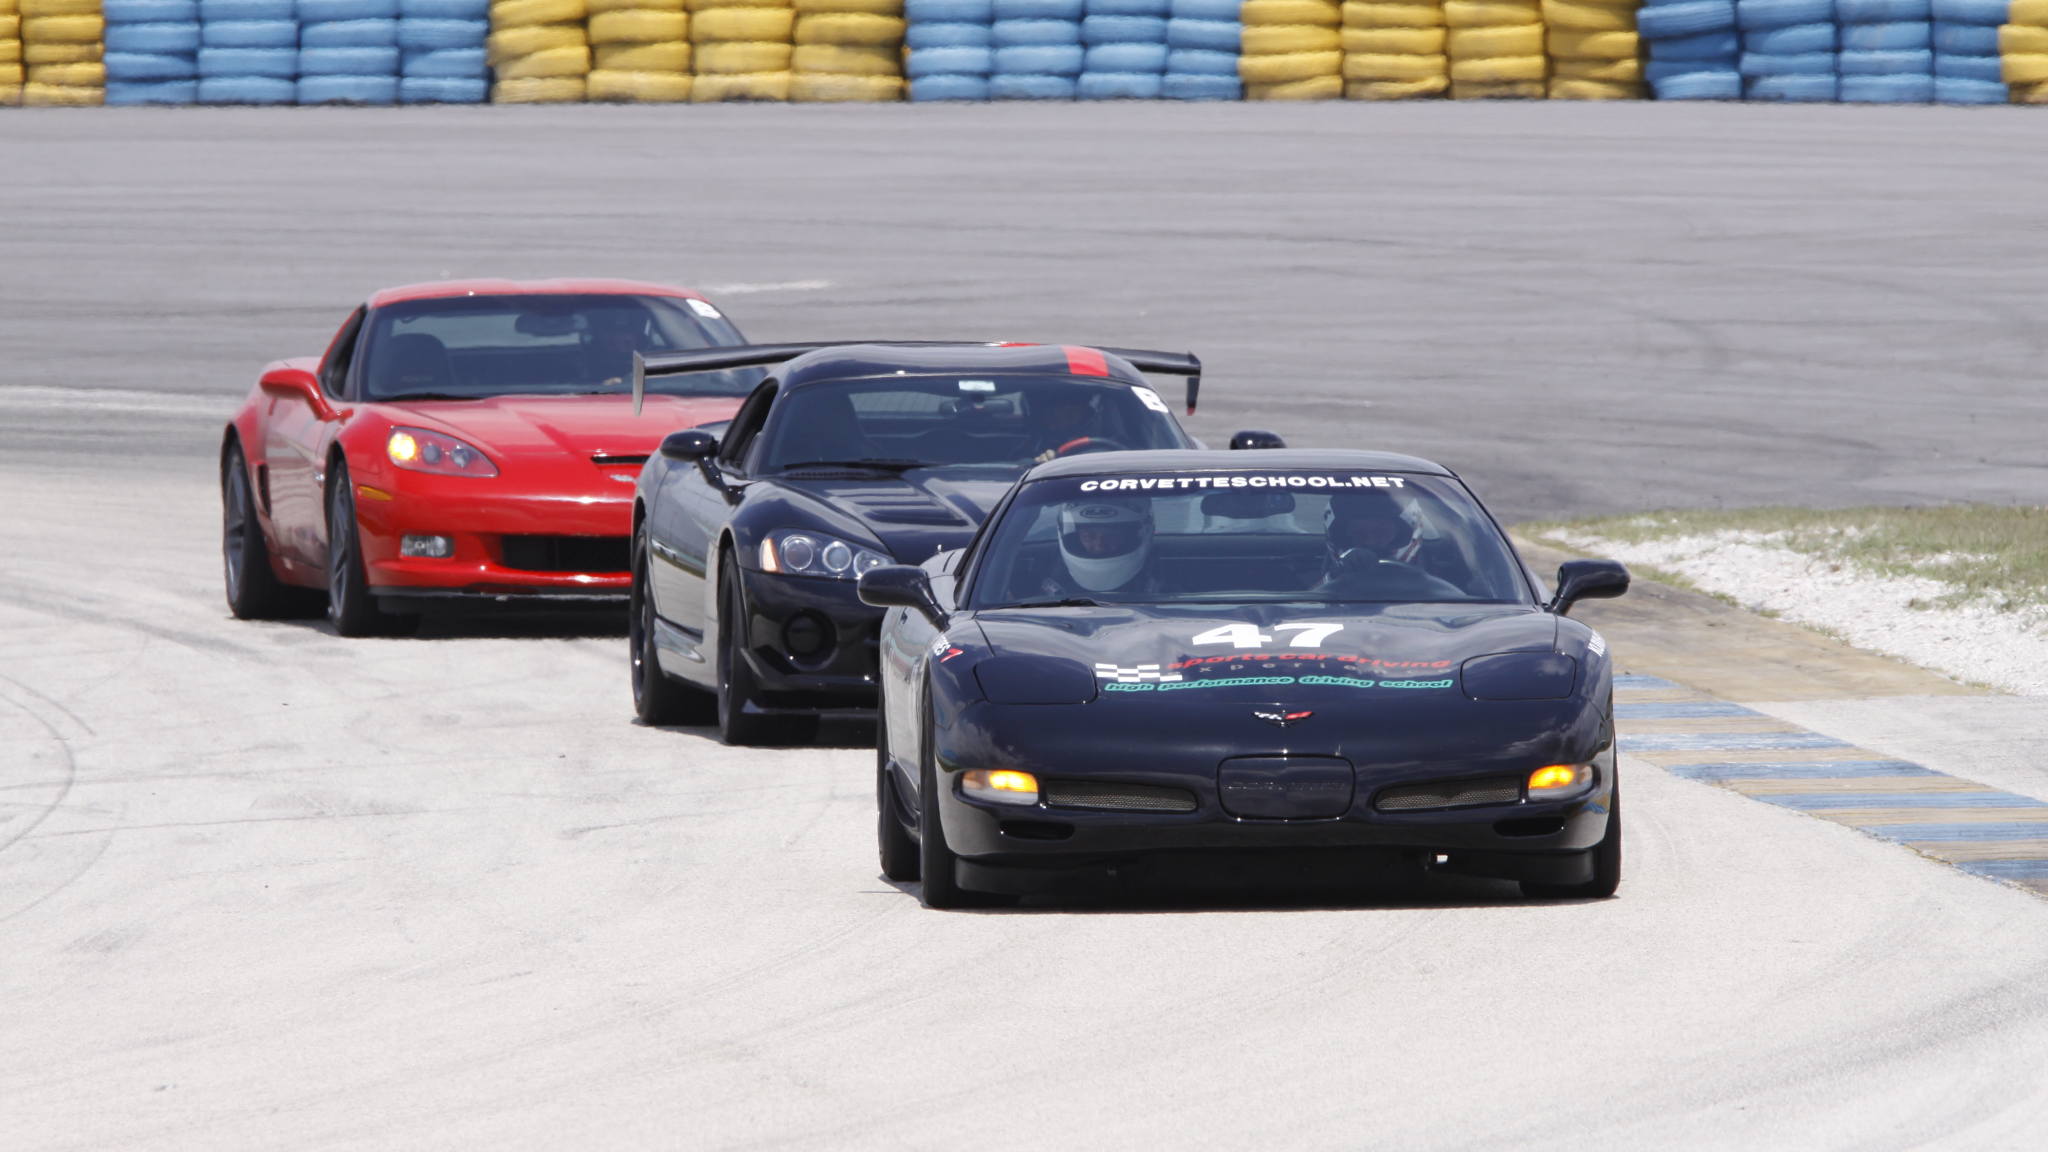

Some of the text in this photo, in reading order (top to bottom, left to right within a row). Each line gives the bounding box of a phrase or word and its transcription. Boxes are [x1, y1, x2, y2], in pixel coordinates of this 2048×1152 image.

[1080, 476, 1405, 492] CORVETTESCHOOL.NET
[1192, 623, 1344, 648] 47
[1104, 675, 1454, 692] high performance driving school
